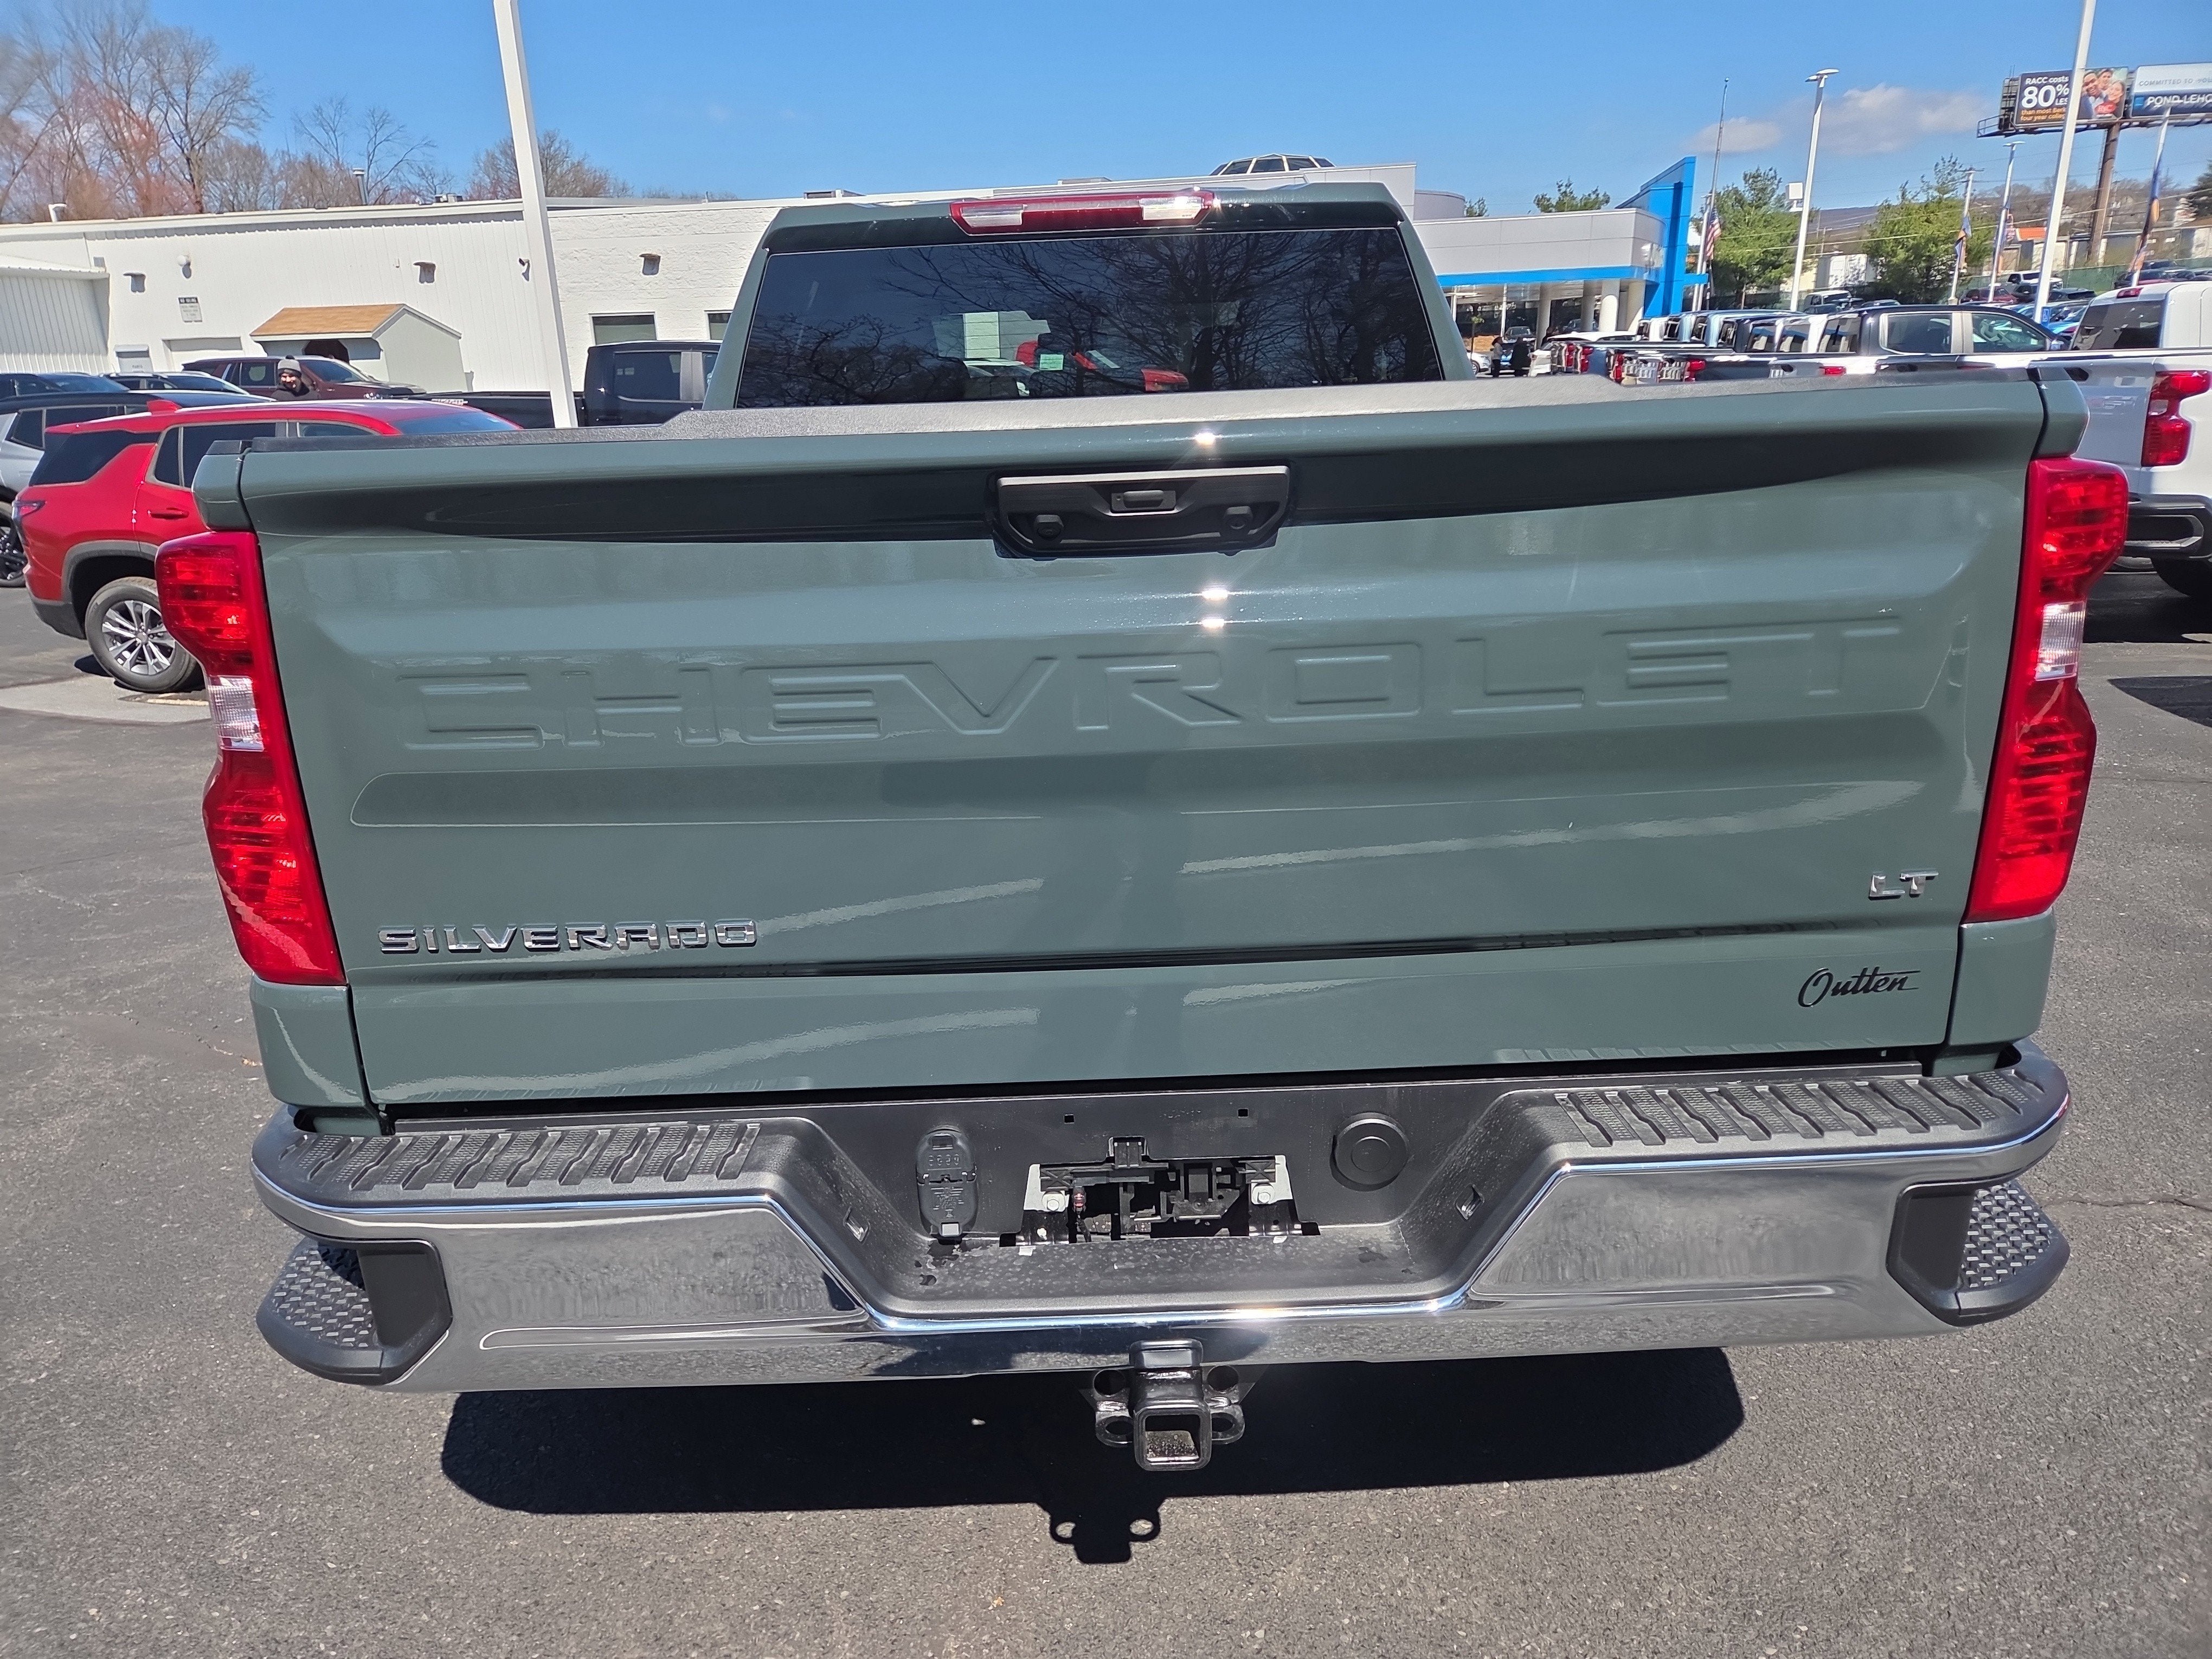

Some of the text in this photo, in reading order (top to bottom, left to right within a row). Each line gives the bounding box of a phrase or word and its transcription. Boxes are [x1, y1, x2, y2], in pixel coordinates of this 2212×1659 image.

[2021, 83, 2069, 108] 80%
[2025, 76, 2048, 85] RACC
[2139, 78, 2181, 86] COMMITTED
[395, 616, 1900, 751] CHEVROLET
[1868, 870, 1939, 901] LT
[378, 920, 757, 953] SILVERADO
[1798, 966, 1921, 1008] Outten
